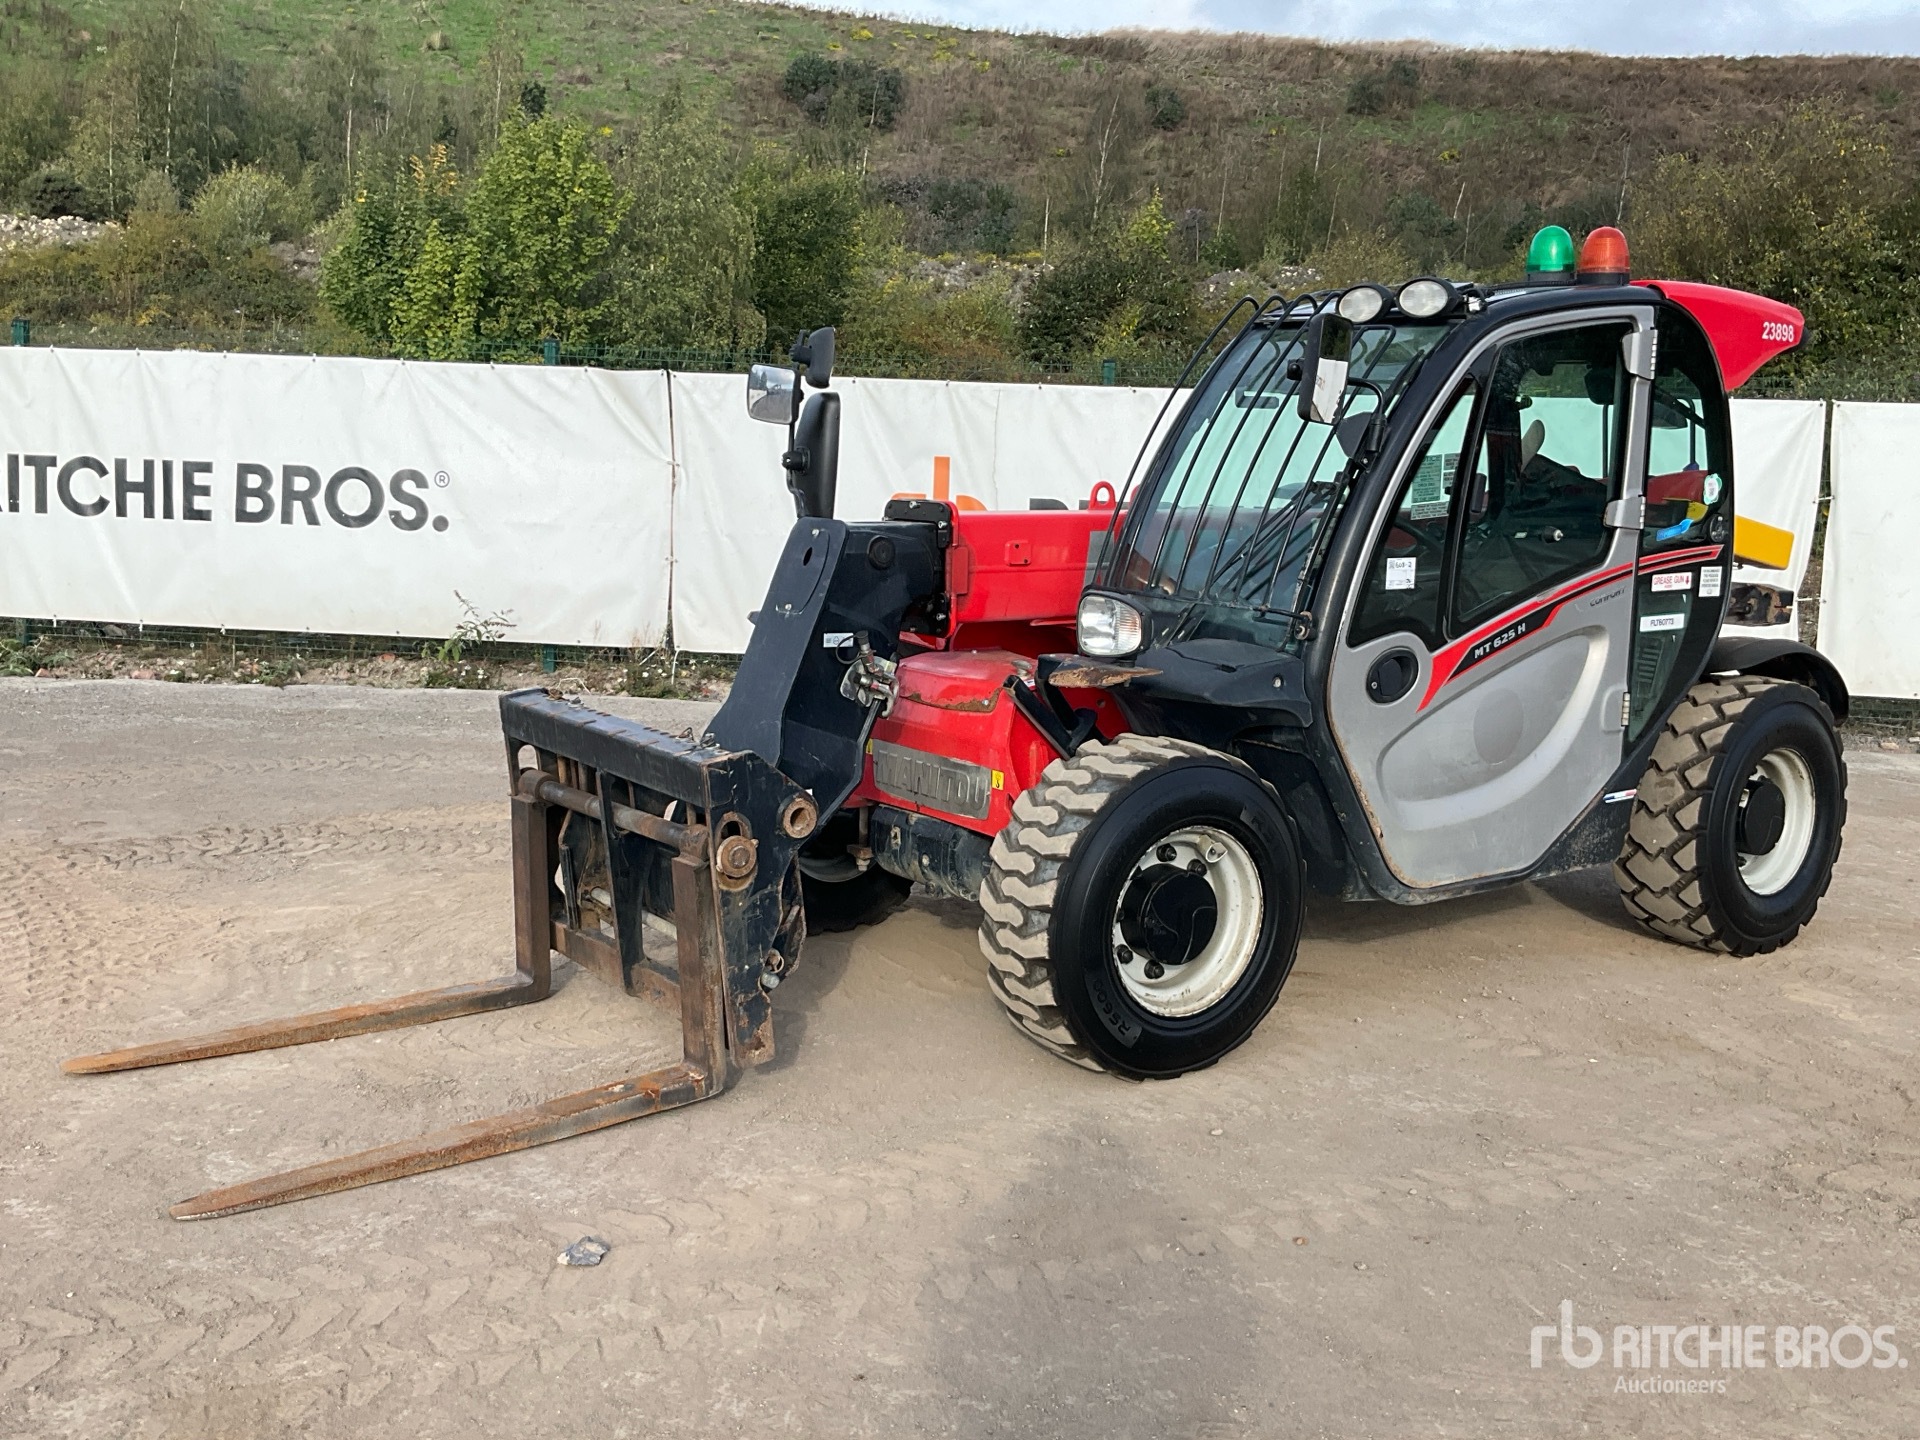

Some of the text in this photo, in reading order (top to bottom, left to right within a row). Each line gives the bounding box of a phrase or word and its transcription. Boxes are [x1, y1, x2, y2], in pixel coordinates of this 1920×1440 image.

[1762, 322, 1794, 342] 23898
[0, 453, 214, 522] ITCHIE
[1653, 575, 1684, 586] GREASE GUN
[1474, 622, 1526, 659] MT 625 H
[877, 749, 989, 811] MANITOU
